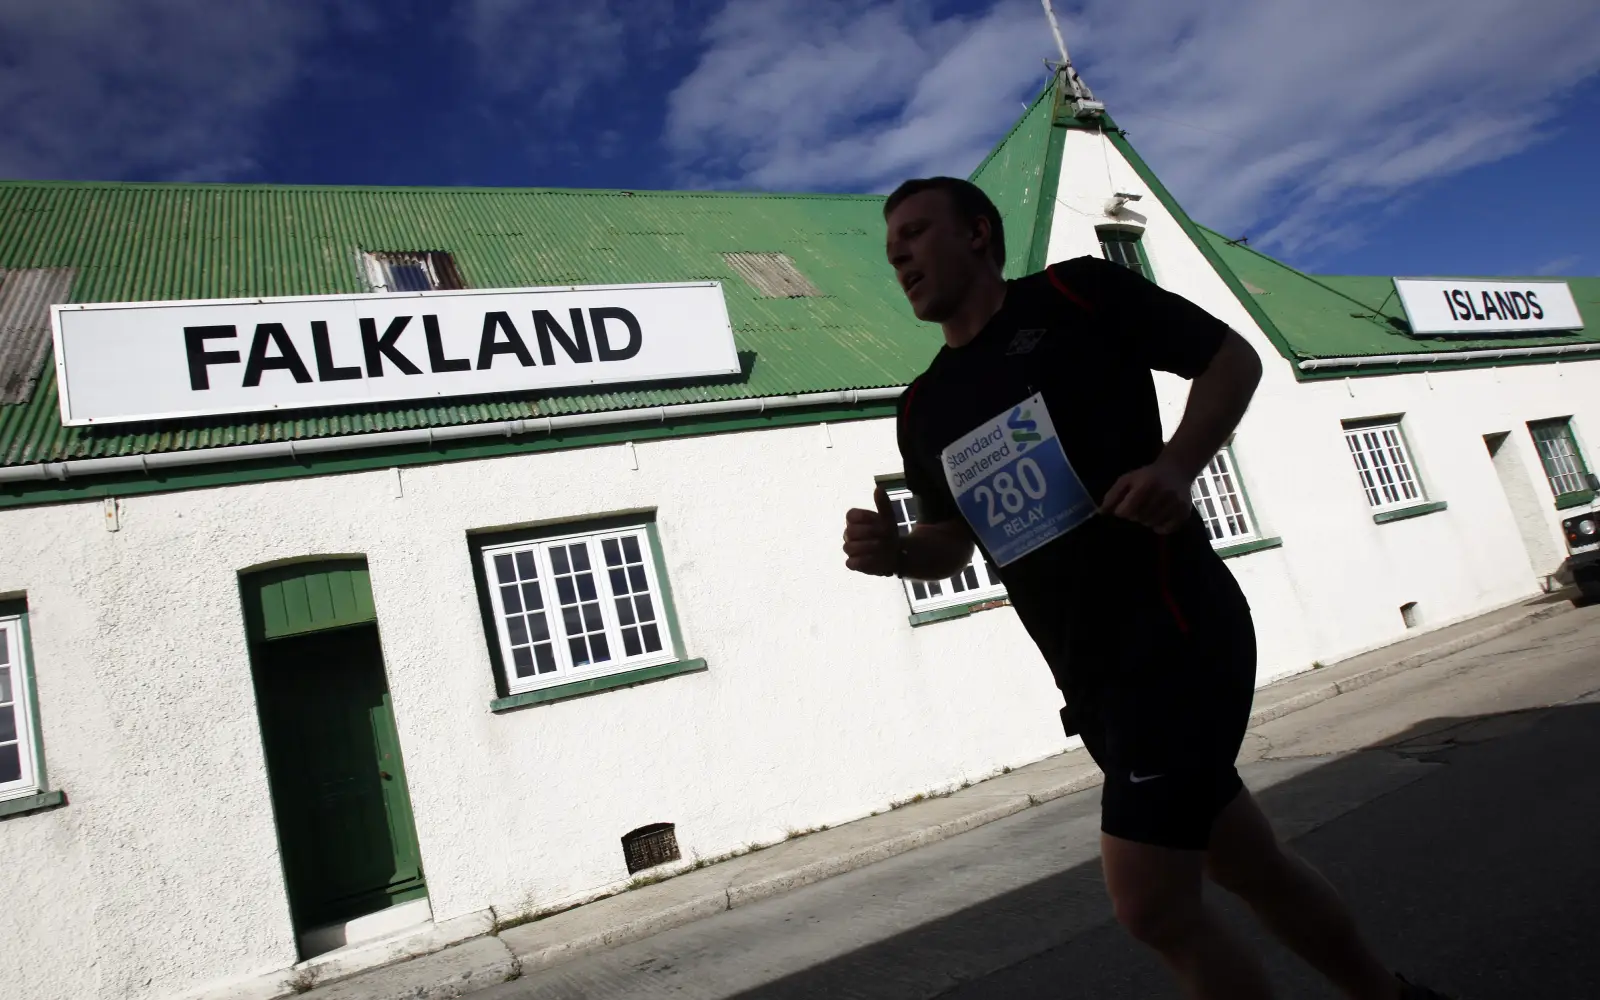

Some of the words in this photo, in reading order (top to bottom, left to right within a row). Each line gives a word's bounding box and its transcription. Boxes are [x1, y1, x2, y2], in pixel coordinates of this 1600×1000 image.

[1443, 290, 1544, 321] ISLANDS
[184, 307, 643, 391] FALKLAND
[946, 425, 1003, 470] Standard
[951, 442, 1011, 488] Chartered
[973, 457, 1047, 528] 280
[1003, 503, 1046, 537] RELAY
